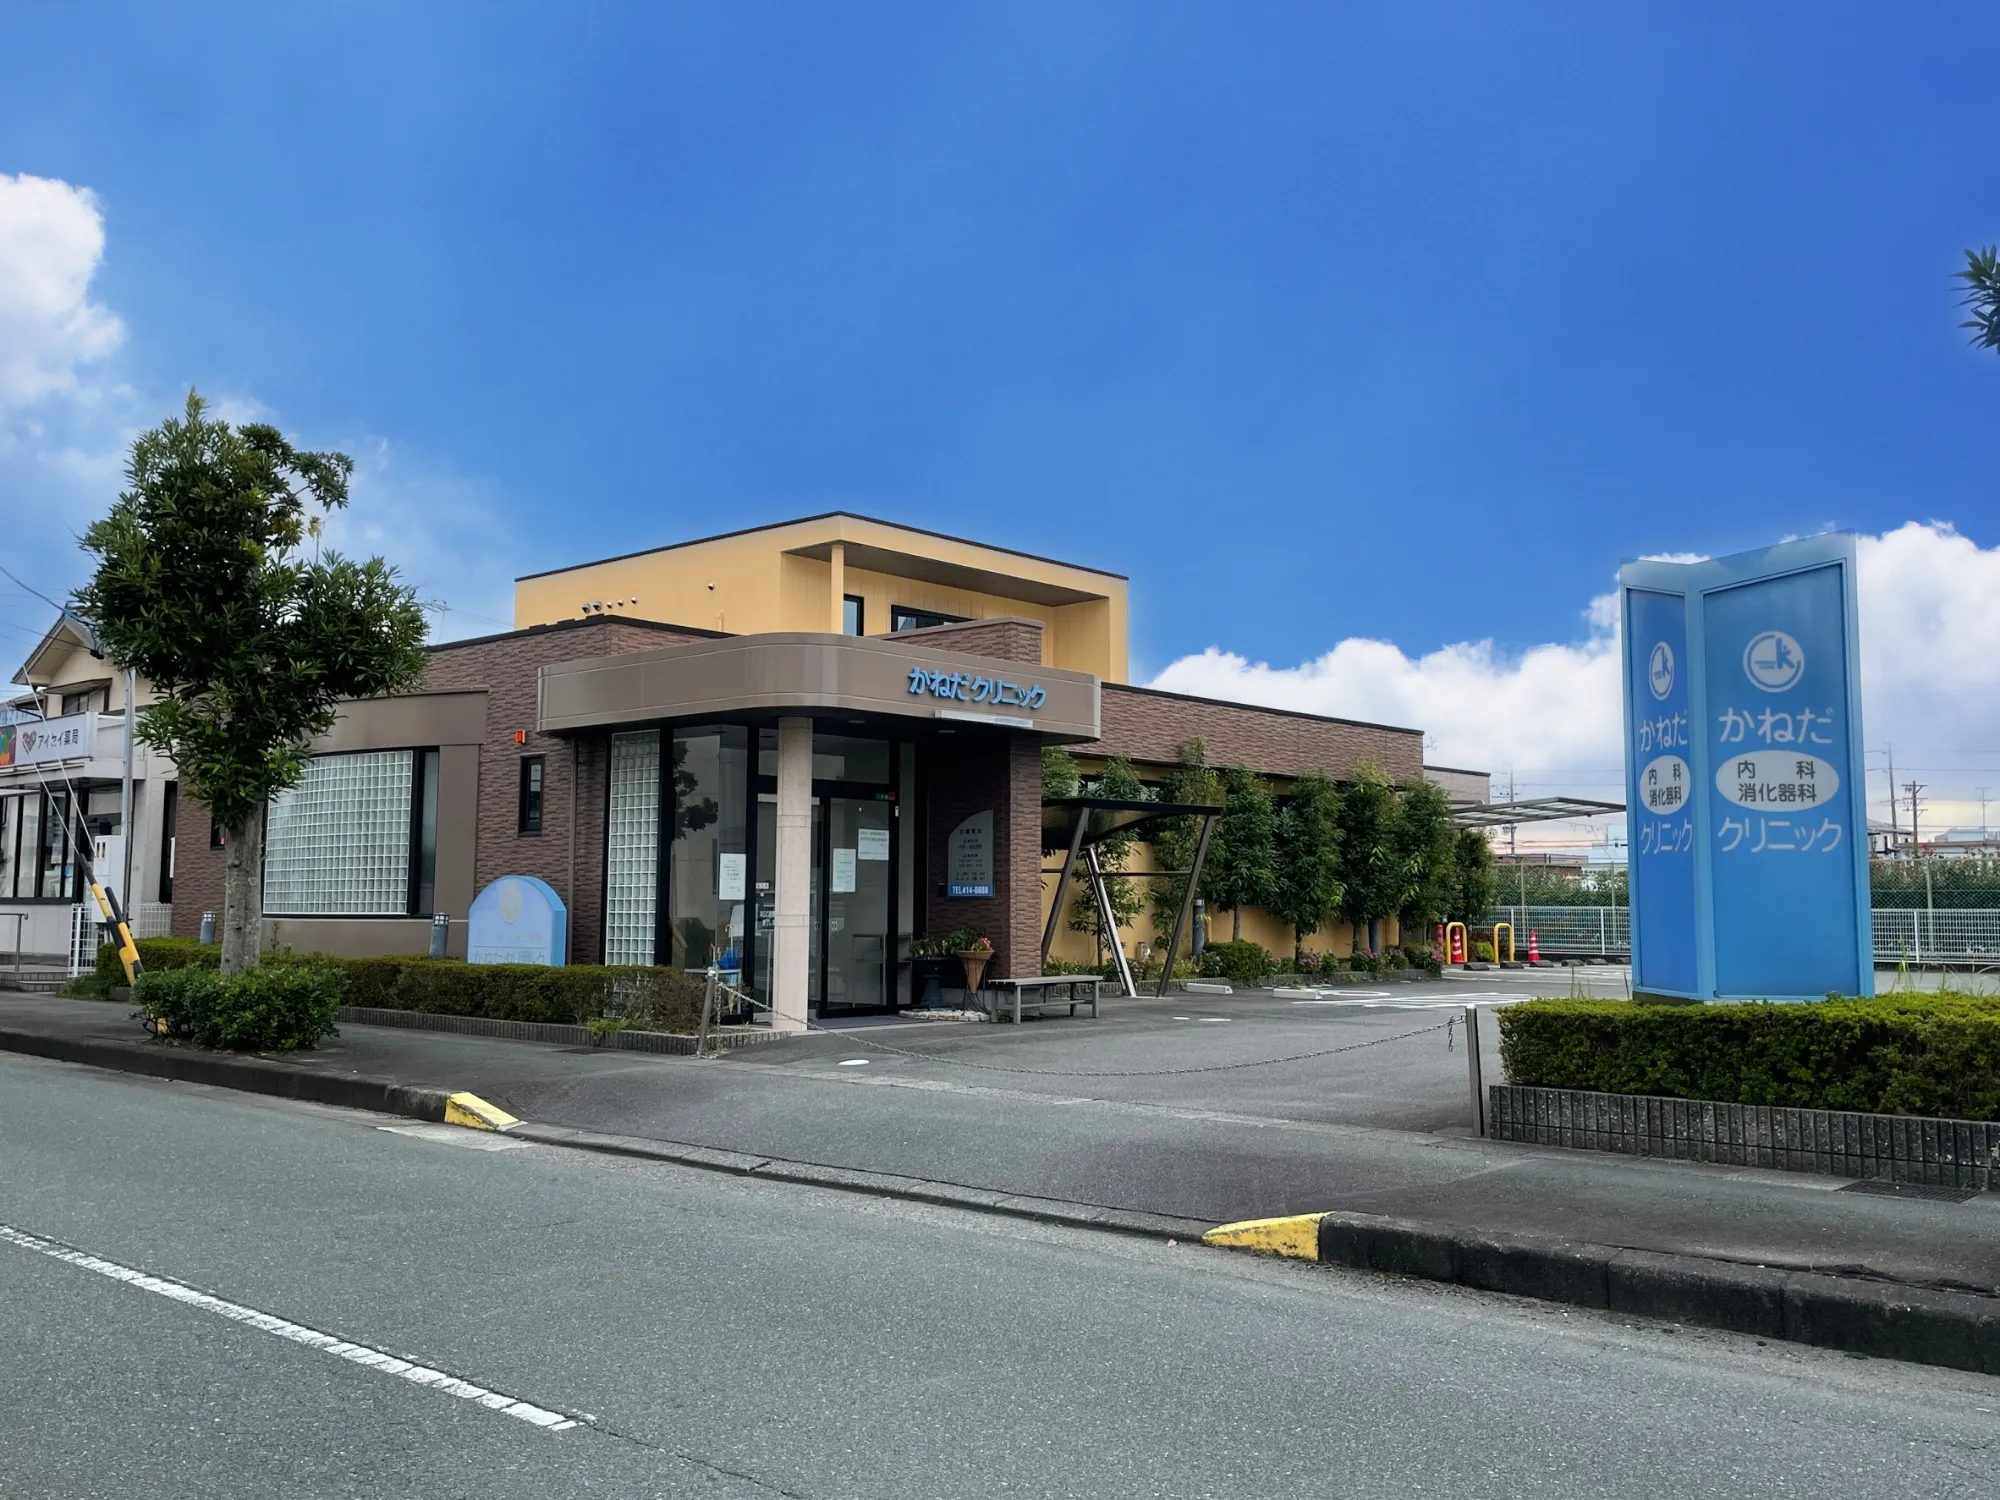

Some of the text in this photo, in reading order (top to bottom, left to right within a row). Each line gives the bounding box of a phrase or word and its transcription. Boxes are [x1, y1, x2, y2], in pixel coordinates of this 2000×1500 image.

[908, 666, 1047, 709] かねだクリニック
[38, 728, 79, 750] アイセイ薬局
[1640, 708, 1688, 752] かねだ
[1718, 707, 1834, 744] かねだ
[1649, 785, 1682, 807] 消化器科
[1738, 783, 1817, 802] 消化器科
[1640, 818, 1692, 855] クリニック
[1717, 816, 1841, 853] クリニック
